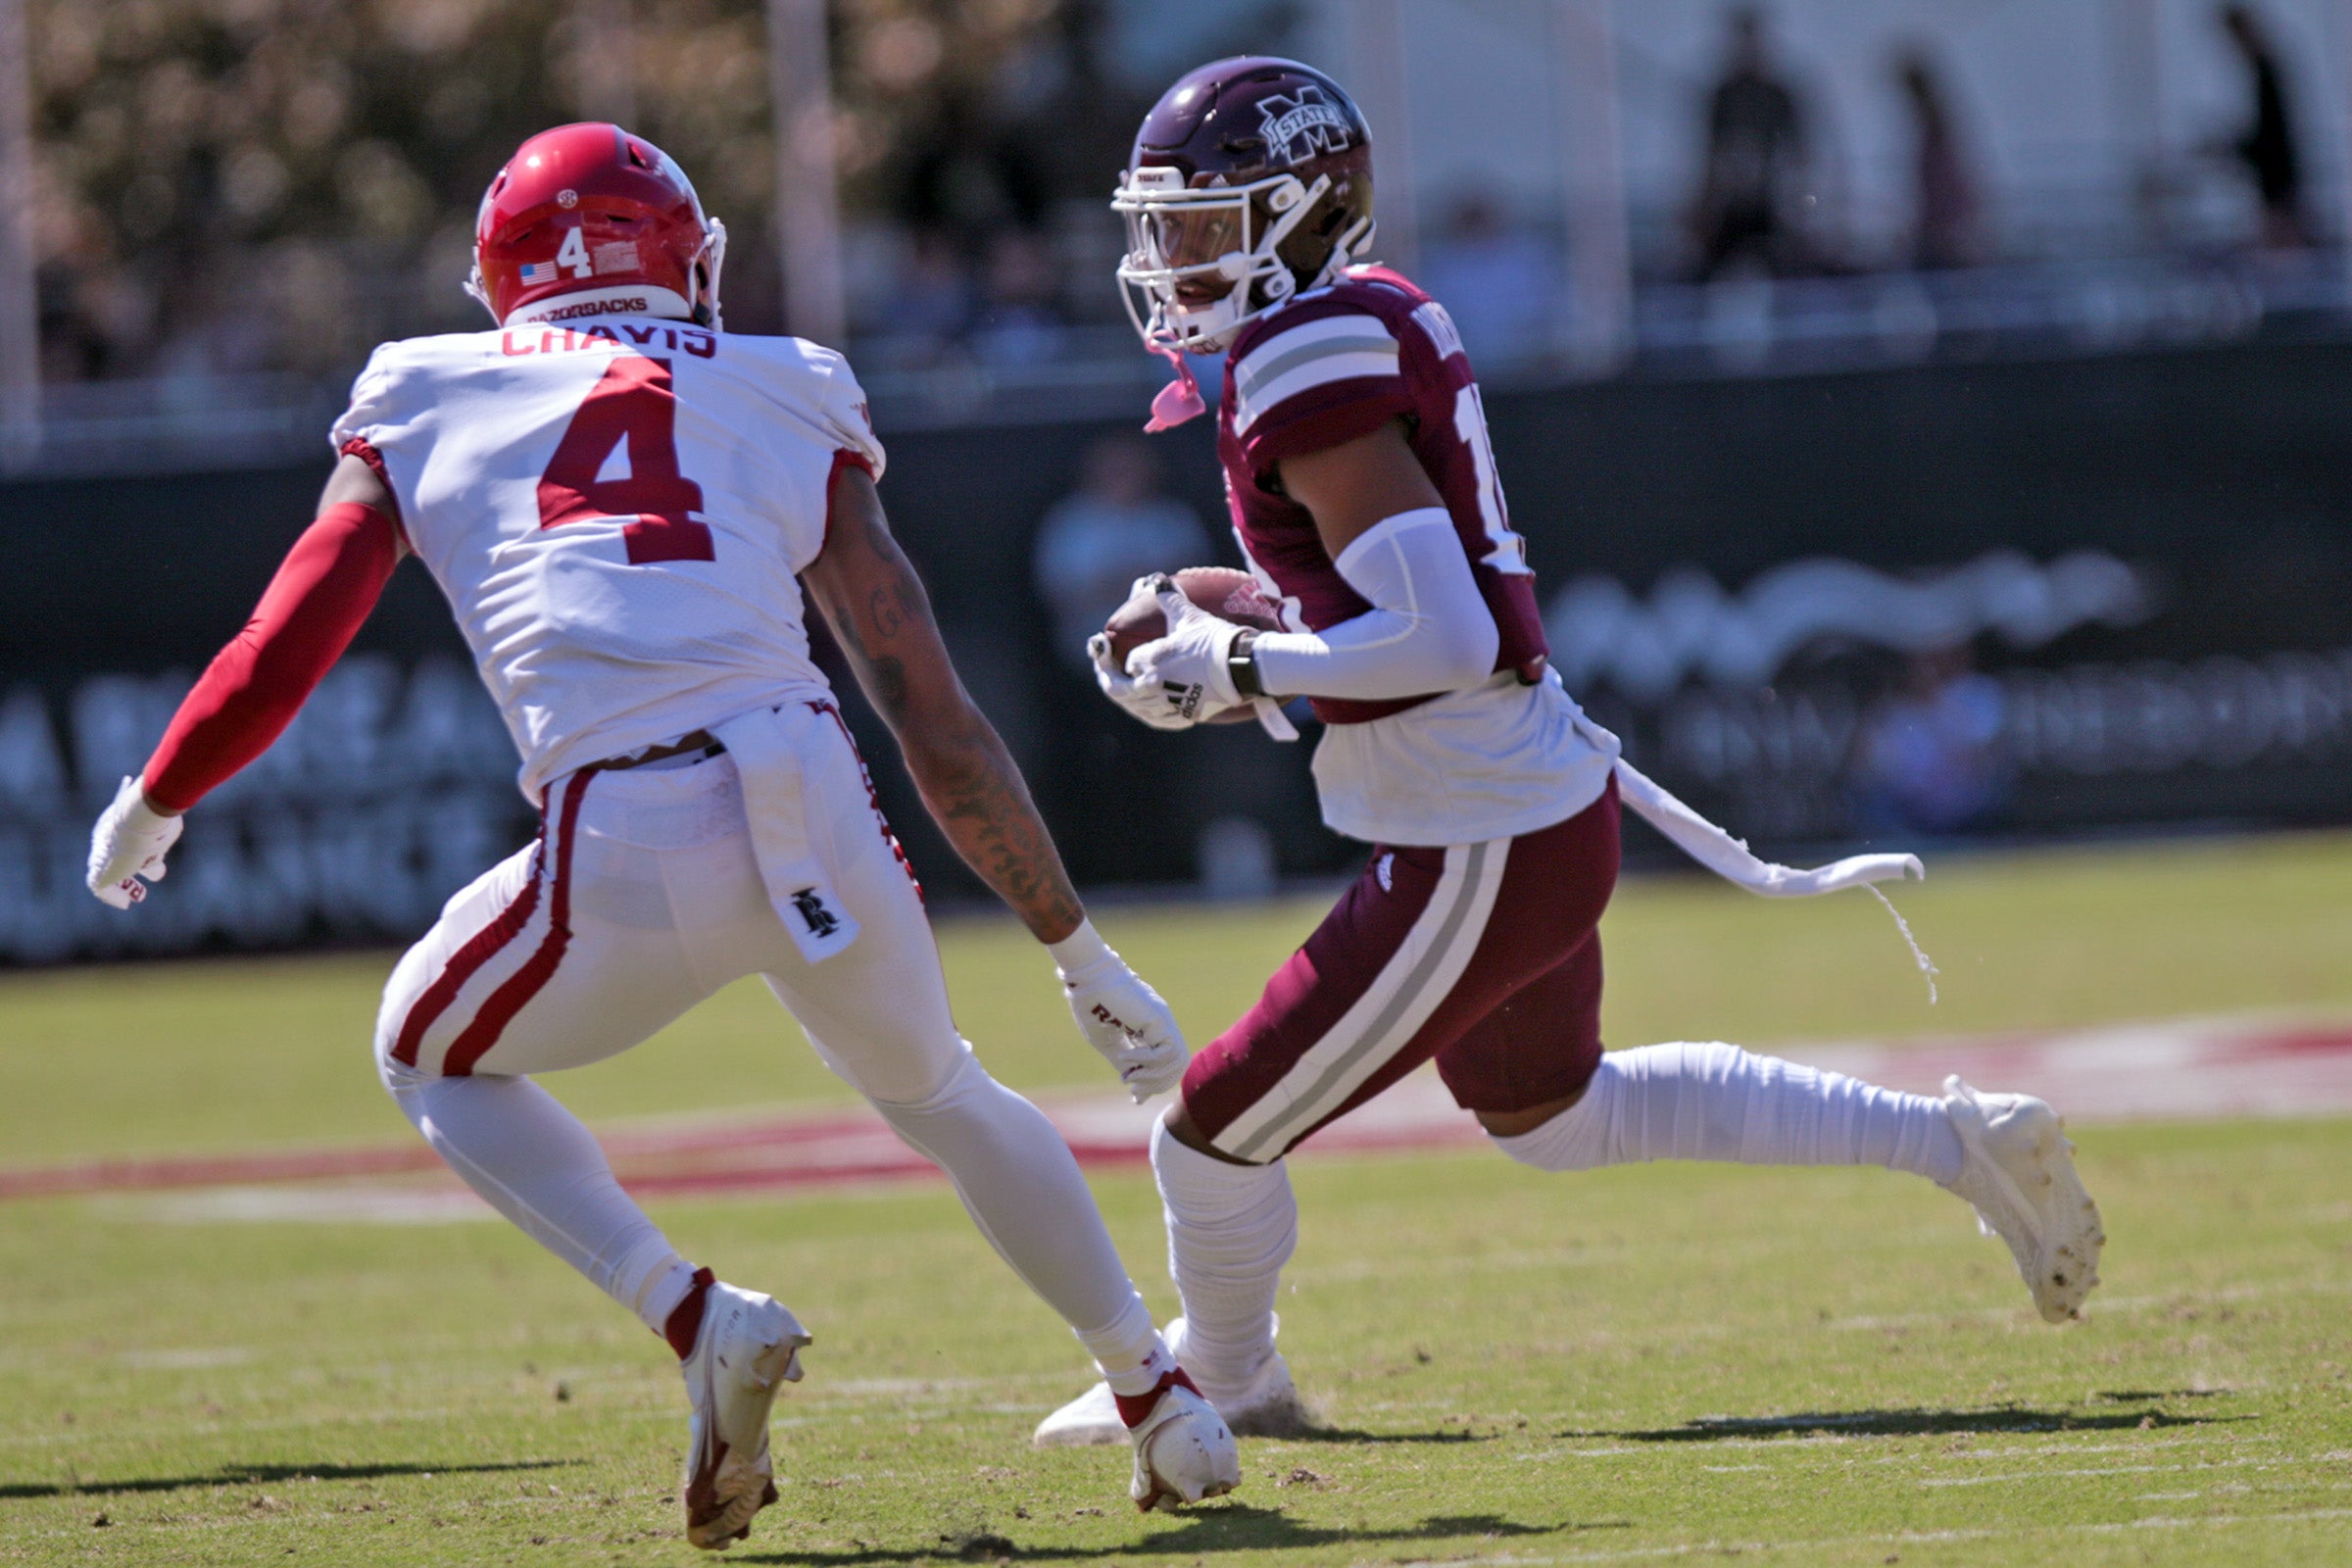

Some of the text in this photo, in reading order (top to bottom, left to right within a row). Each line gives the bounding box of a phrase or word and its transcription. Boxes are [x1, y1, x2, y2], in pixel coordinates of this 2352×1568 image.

[1280, 106, 1336, 137] STATE
[557, 225, 593, 278] 4
[502, 323, 717, 360] CHAVIS
[536, 356, 716, 564] 4
[1182, 682, 1203, 719] adidas
